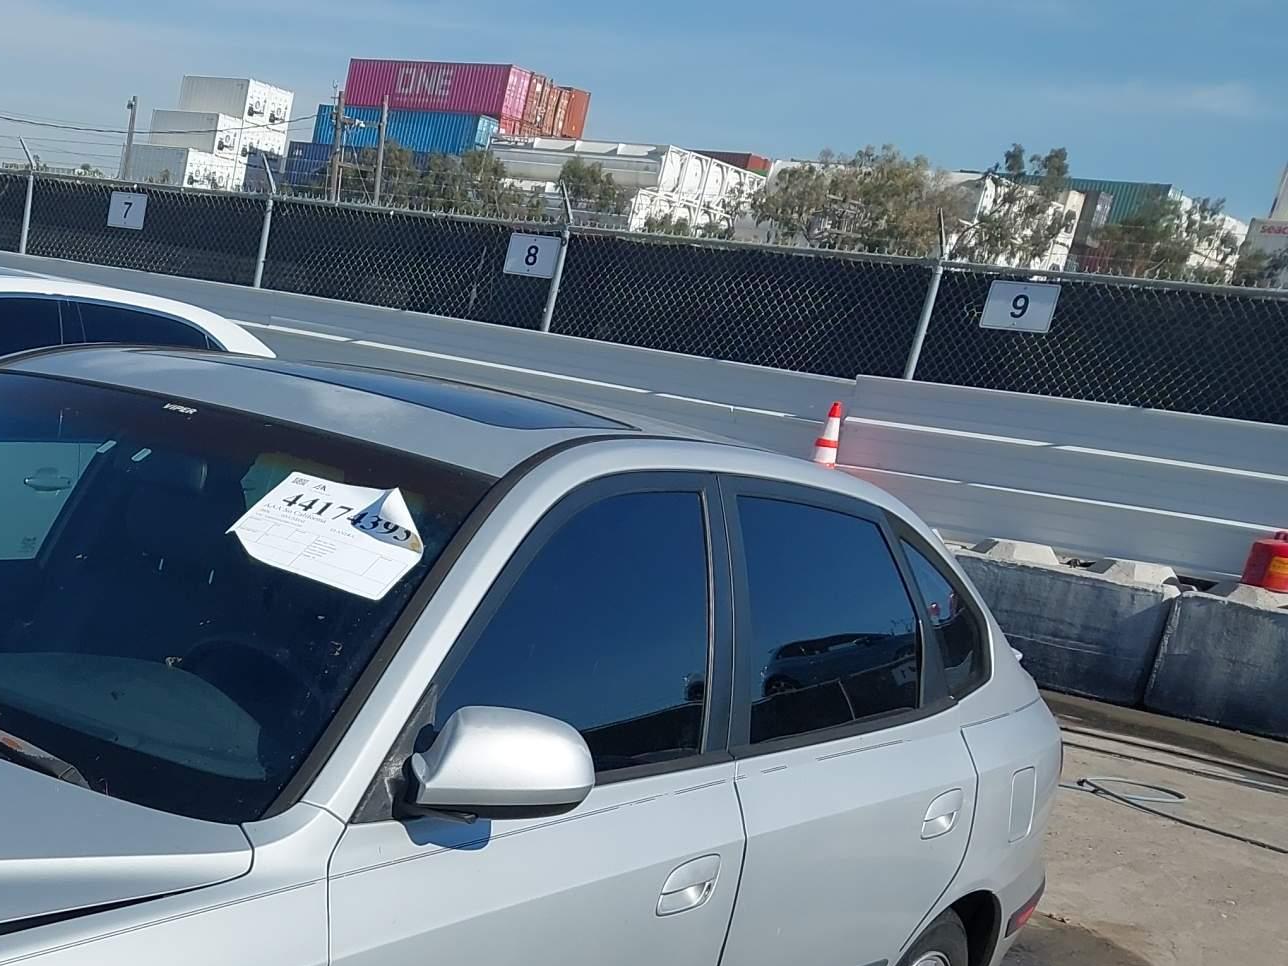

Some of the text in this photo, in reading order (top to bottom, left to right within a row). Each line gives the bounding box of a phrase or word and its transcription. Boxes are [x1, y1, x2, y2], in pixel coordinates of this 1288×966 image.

[397, 66, 452, 96] ONE
[124, 201, 133, 219] 7
[525, 245, 539, 266] 8
[1010, 294, 1030, 319] 9
[162, 403, 197, 415] VIPER
